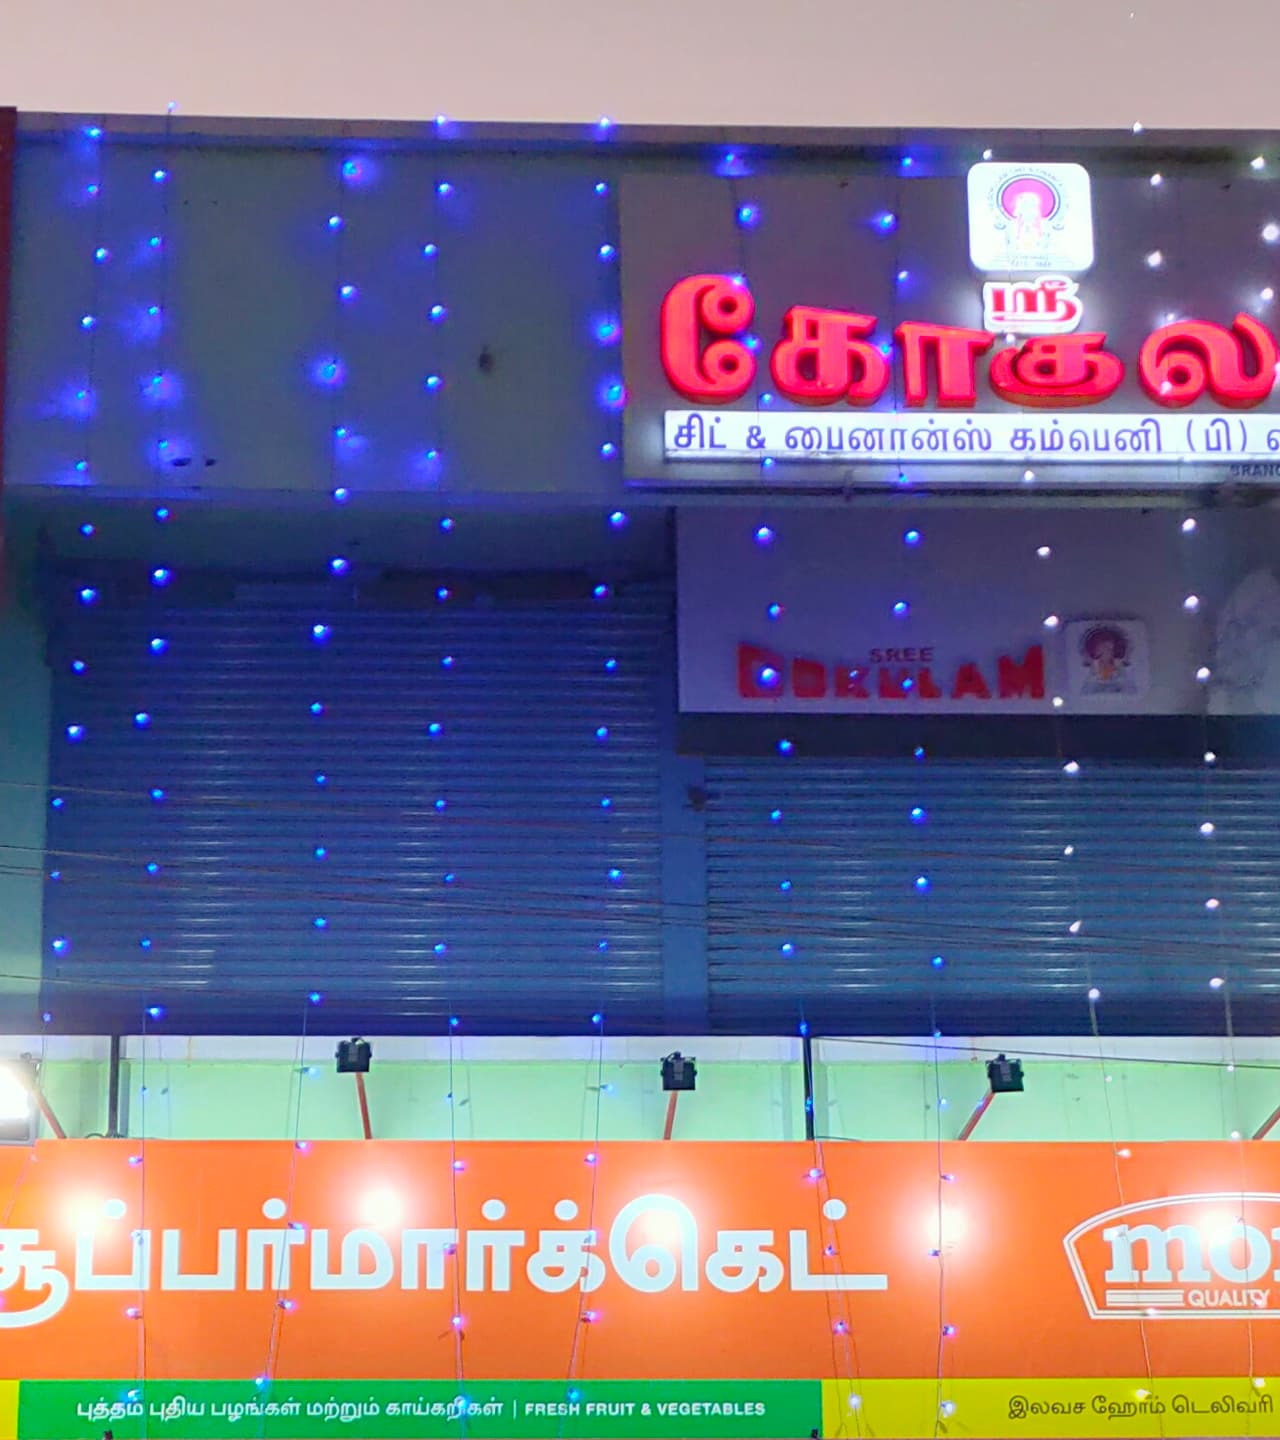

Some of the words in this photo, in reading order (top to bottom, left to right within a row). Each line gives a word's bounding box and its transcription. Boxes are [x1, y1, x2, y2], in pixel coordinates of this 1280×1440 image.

[673, 413, 728, 450] சிட்
[746, 424, 767, 450] &
[784, 418, 993, 451] பைனான்ஸ்
[1009, 417, 1162, 452] கம்பெனி
[1185, 417, 1249, 453] (பி)
[870, 646, 934, 663] SREE
[1187, 1288, 1271, 1309] QUALITY
[149, 1396, 206, 1422] புதிய
[306, 1396, 380, 1422] மற்றும்
[524, 1401, 580, 1417] FRESH
[585, 1401, 635, 1417] FRUIT
[640, 1402, 654, 1417] &
[657, 1401, 767, 1417] VEGETABLES
[1007, 1395, 1087, 1420] இலவச
